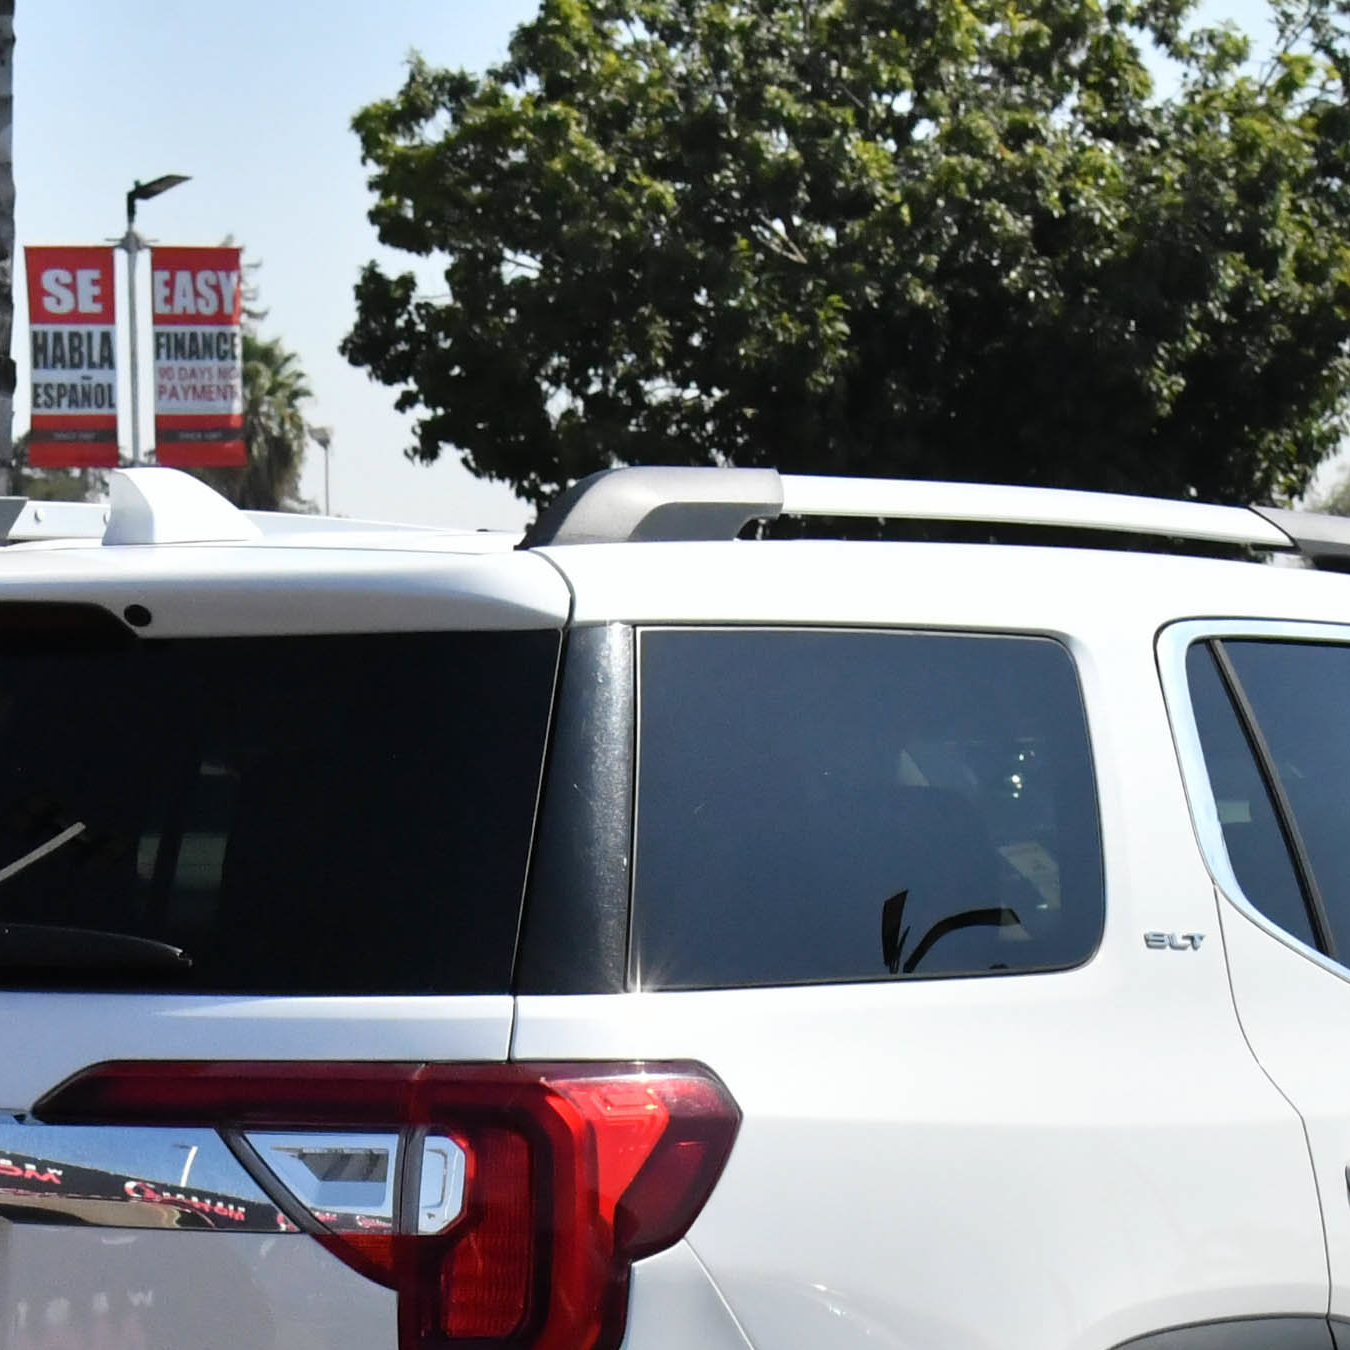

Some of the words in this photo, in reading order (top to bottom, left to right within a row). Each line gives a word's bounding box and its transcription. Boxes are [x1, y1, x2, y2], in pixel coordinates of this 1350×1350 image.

[41, 268, 103, 315] SE
[153, 269, 239, 315] EASY
[32, 330, 115, 370] HABLA
[154, 331, 237, 361] FINANCE
[33, 375, 115, 409] ESPAÑOL
[1143, 932, 1205, 951] SLT
